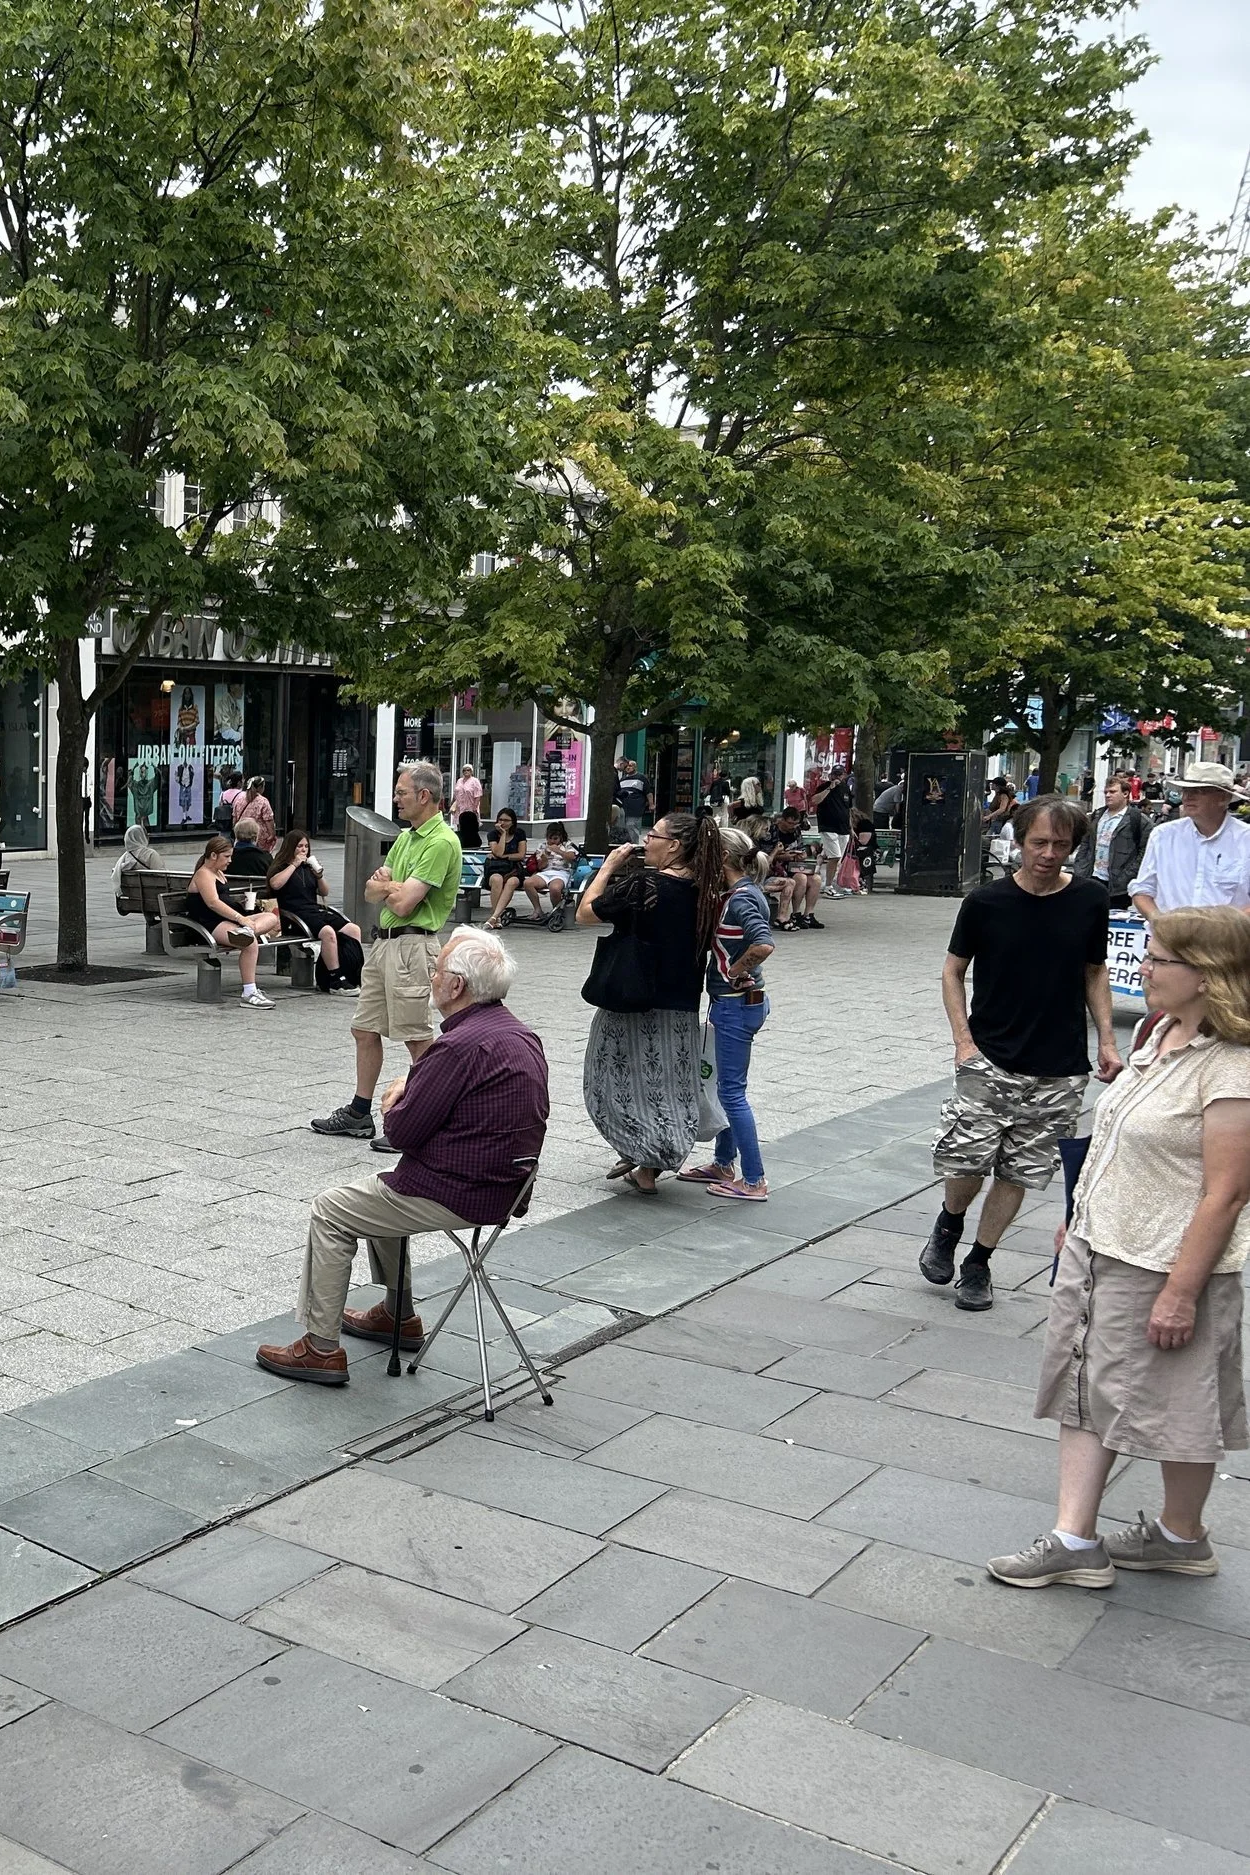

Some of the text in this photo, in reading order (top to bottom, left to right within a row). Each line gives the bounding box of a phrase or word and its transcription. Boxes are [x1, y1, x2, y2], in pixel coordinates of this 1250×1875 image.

[403, 717, 422, 728] MORE
[137, 744, 242, 766] URBAN OUTFITTERS
[817, 751, 848, 767] SALE
[1107, 930, 1135, 948] REE
